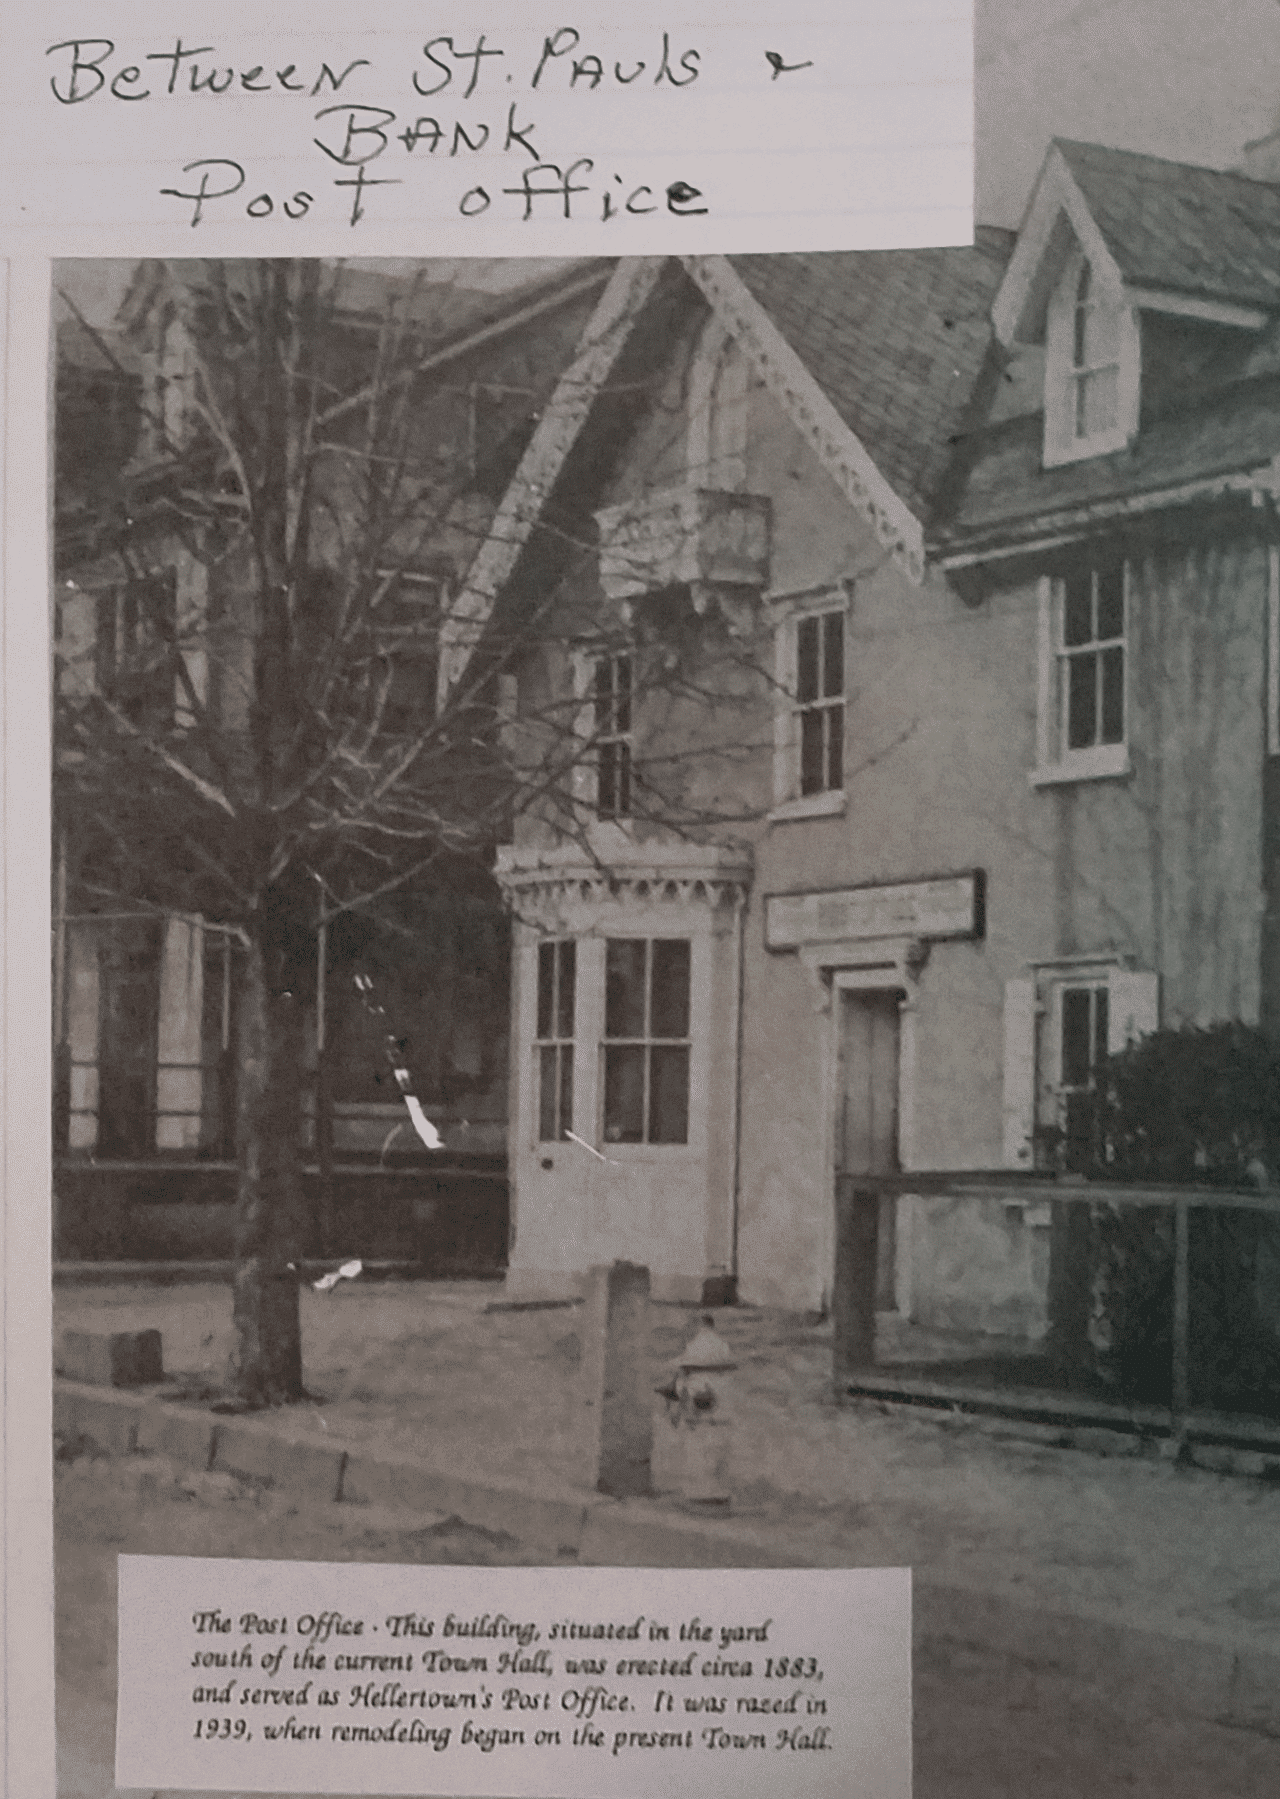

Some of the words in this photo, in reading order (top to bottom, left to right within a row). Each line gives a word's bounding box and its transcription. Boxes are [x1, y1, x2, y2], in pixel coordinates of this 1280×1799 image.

[192, 1609, 232, 1633] The
[239, 1612, 288, 1634] Post
[297, 1611, 364, 1643] Office
[386, 1613, 434, 1637] This
[441, 1613, 541, 1646] building,
[548, 1616, 645, 1640] situated
[649, 1620, 670, 1641] in
[679, 1617, 713, 1642] the
[718, 1618, 773, 1650] yard
[191, 1643, 252, 1668] south
[260, 1644, 287, 1678] of
[293, 1645, 326, 1670] the
[334, 1653, 413, 1672] current
[422, 1649, 488, 1673] Town
[496, 1648, 553, 1678] Hall,
[565, 1658, 607, 1674] was
[615, 1652, 697, 1676] erected
[701, 1655, 752, 1677] circa
[764, 1656, 824, 1682] 1883,
[192, 1679, 237, 1703] and
[240, 1680, 313, 1705] served
[317, 1691, 340, 1706] as
[348, 1682, 492, 1709] Hellertown's
[501, 1687, 551, 1710] Post
[561, 1685, 635, 1718] Office.
[655, 1690, 673, 1713] It
[684, 1697, 728, 1713] was
[736, 1690, 802, 1714] razed
[807, 1694, 828, 1715] in
[193, 1718, 252, 1741] 1939,
[263, 1715, 321, 1740] when
[331, 1719, 452, 1752] remodeling
[461, 1719, 525, 1753] began
[534, 1730, 561, 1746] on
[572, 1721, 604, 1746] the
[612, 1729, 693, 1756] present
[701, 1726, 766, 1749] Town
[775, 1725, 833, 1750] Hall.
